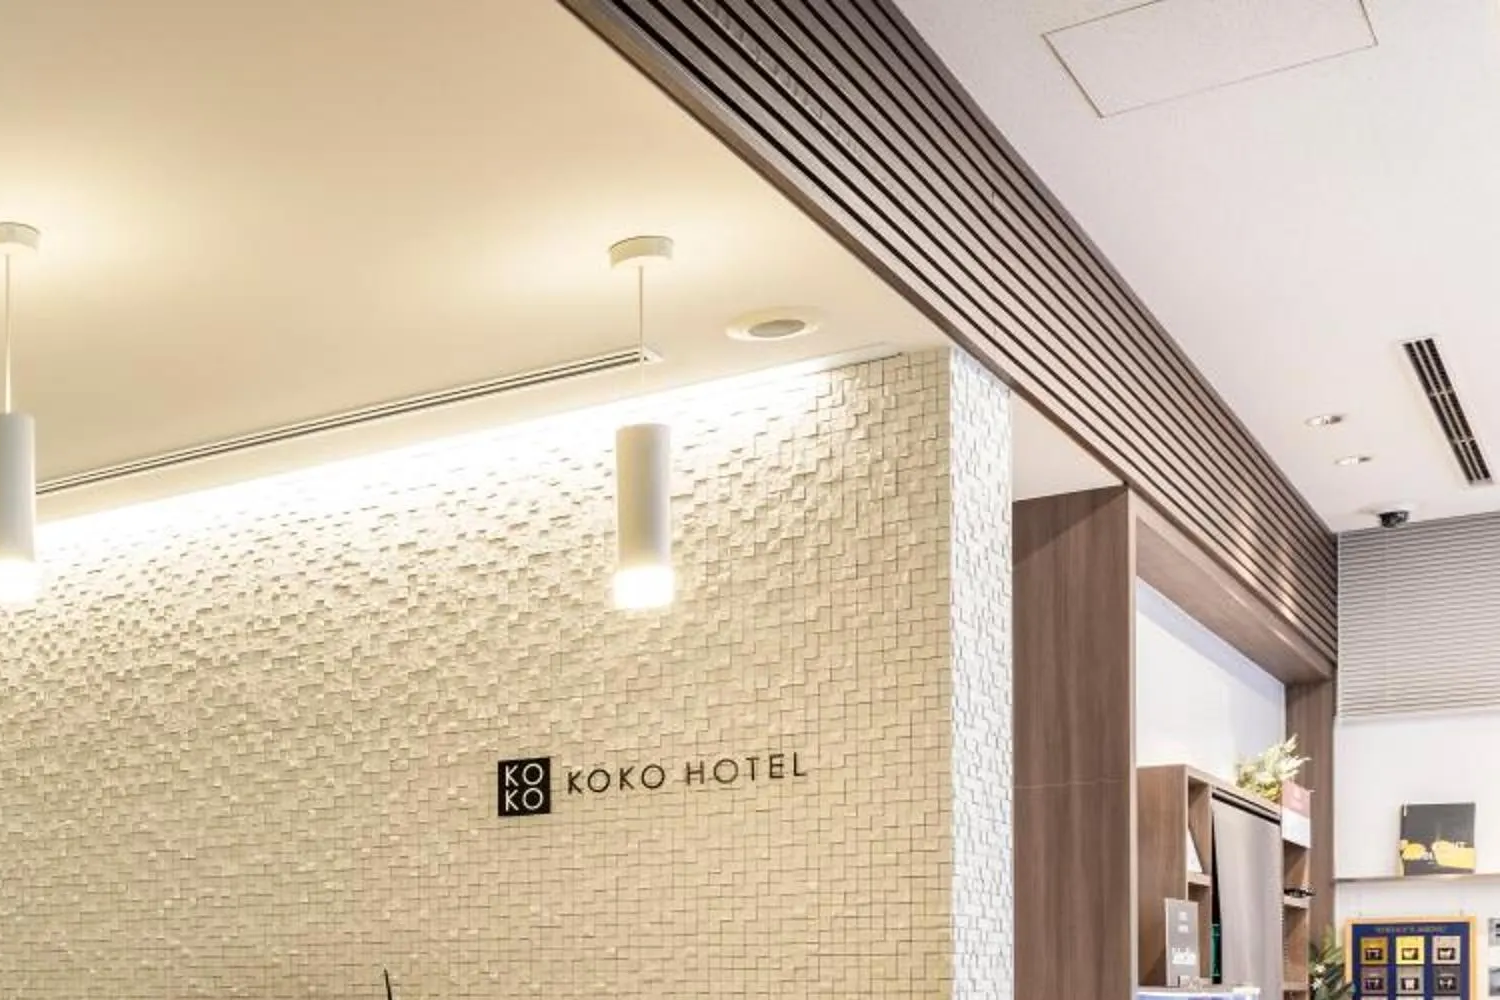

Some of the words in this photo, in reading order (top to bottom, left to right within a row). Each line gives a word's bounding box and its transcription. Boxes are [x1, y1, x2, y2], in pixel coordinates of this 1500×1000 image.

[504, 762, 544, 787] KO
[567, 763, 666, 795] KOKO
[685, 751, 807, 786] HOTEL
[504, 787, 544, 812] KO
